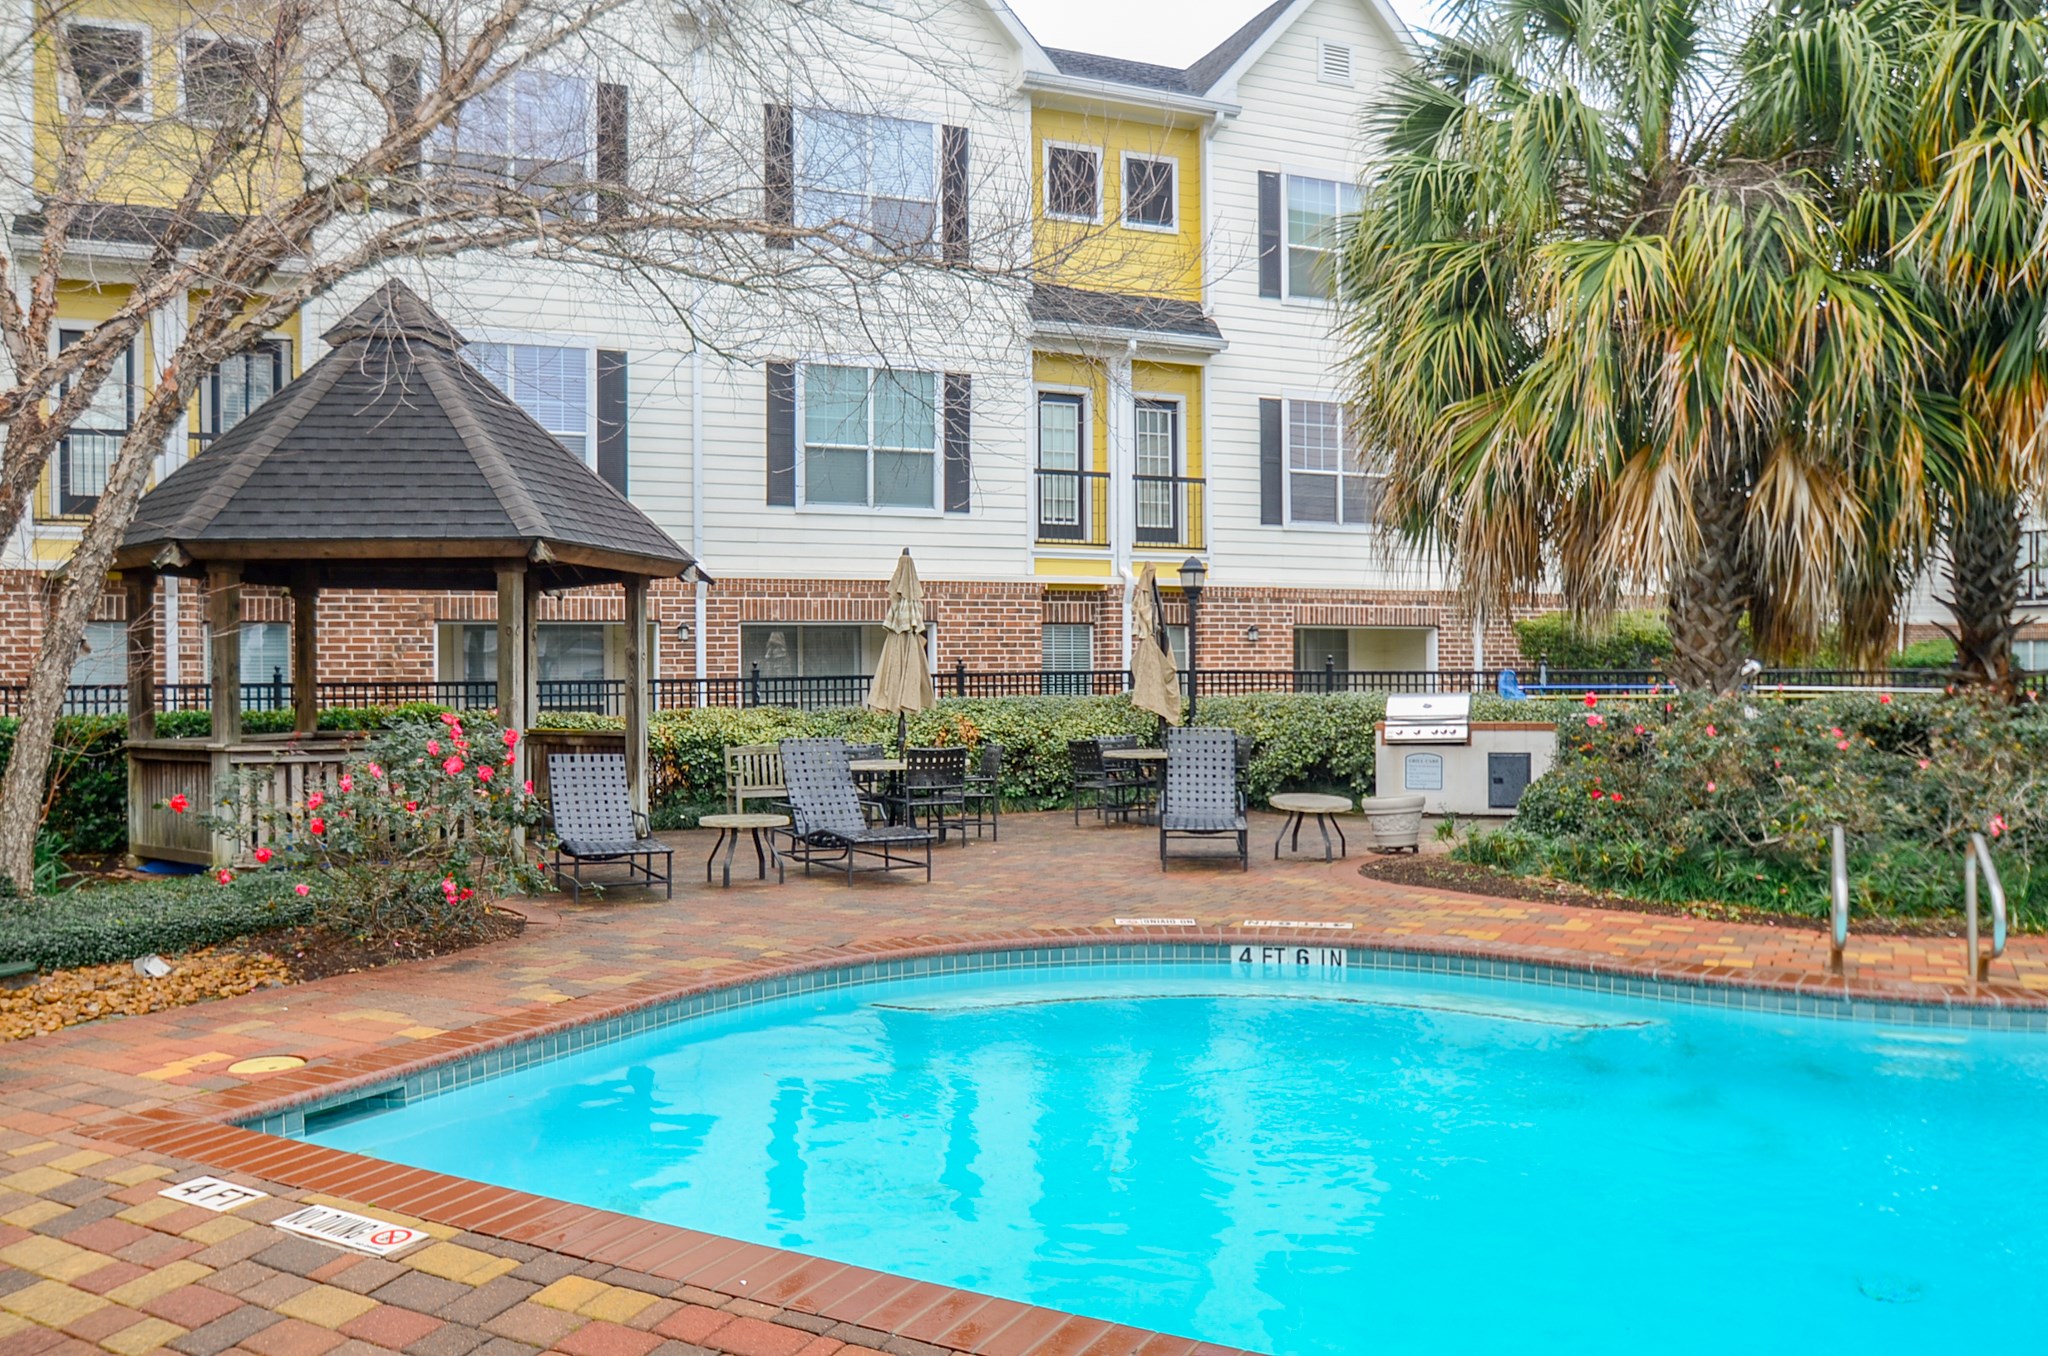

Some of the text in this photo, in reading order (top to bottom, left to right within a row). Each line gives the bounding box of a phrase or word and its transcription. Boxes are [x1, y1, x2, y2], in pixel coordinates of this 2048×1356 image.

[1239, 947, 1342, 967] 4 FT 6 IN
[181, 1183, 256, 1206] 4 FT
[282, 1208, 378, 1239] NO DIVING
